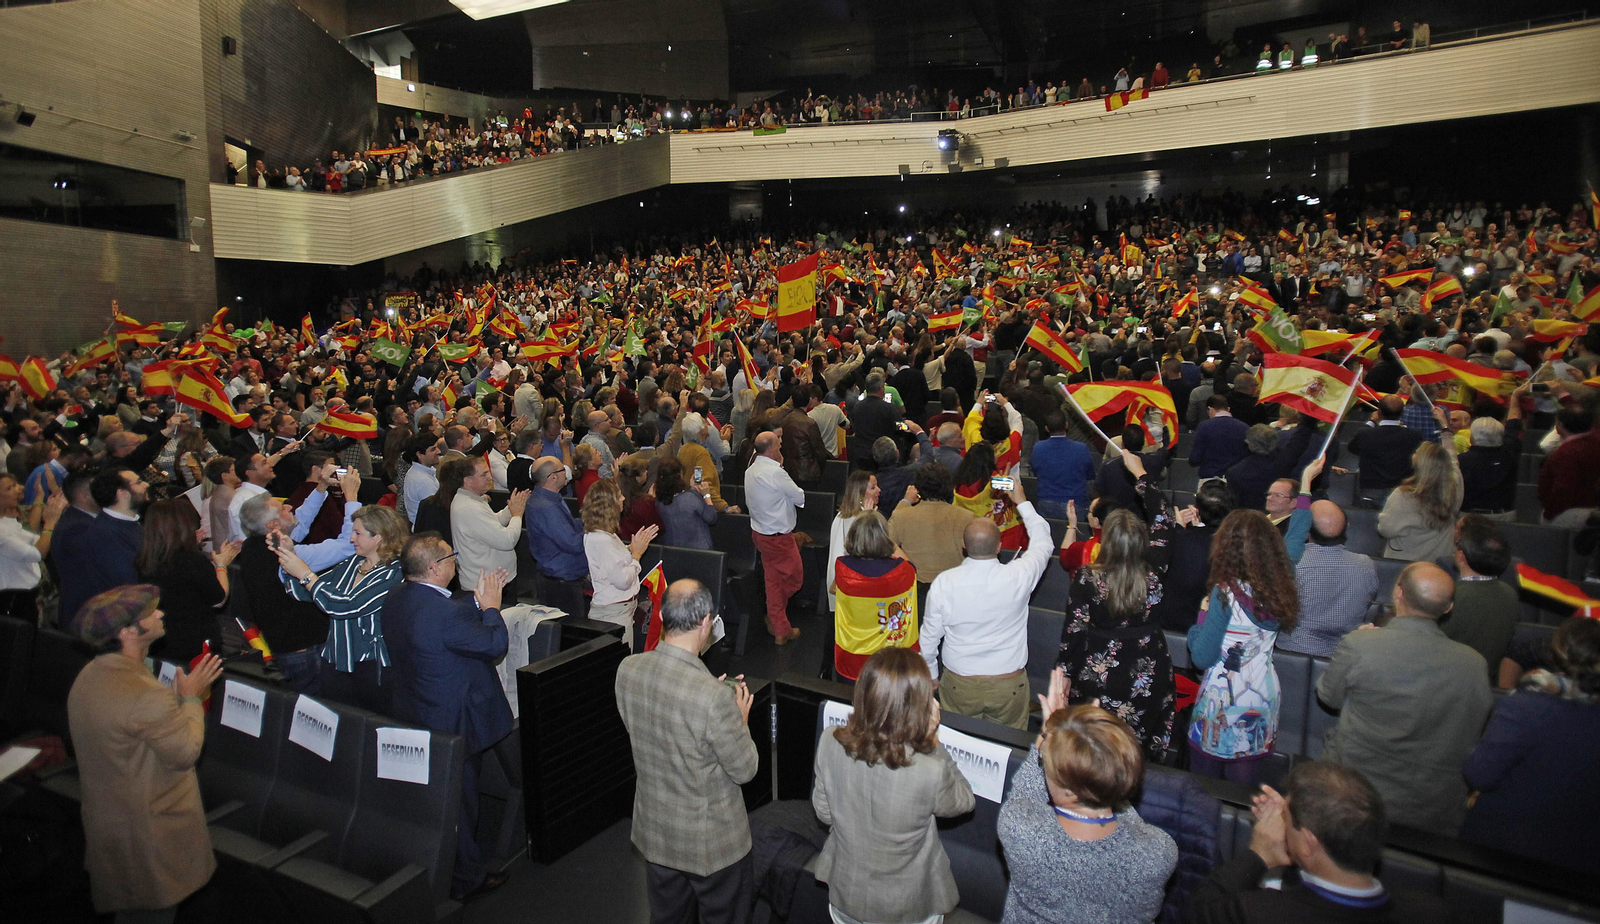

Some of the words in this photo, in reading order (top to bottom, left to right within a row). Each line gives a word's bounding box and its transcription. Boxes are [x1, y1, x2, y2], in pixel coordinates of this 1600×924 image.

[1271, 314, 1302, 347] VOX
[297, 710, 332, 738] RESERVADO
[381, 743, 426, 764] RESERVADO
[943, 743, 1000, 780] ESERVADO
